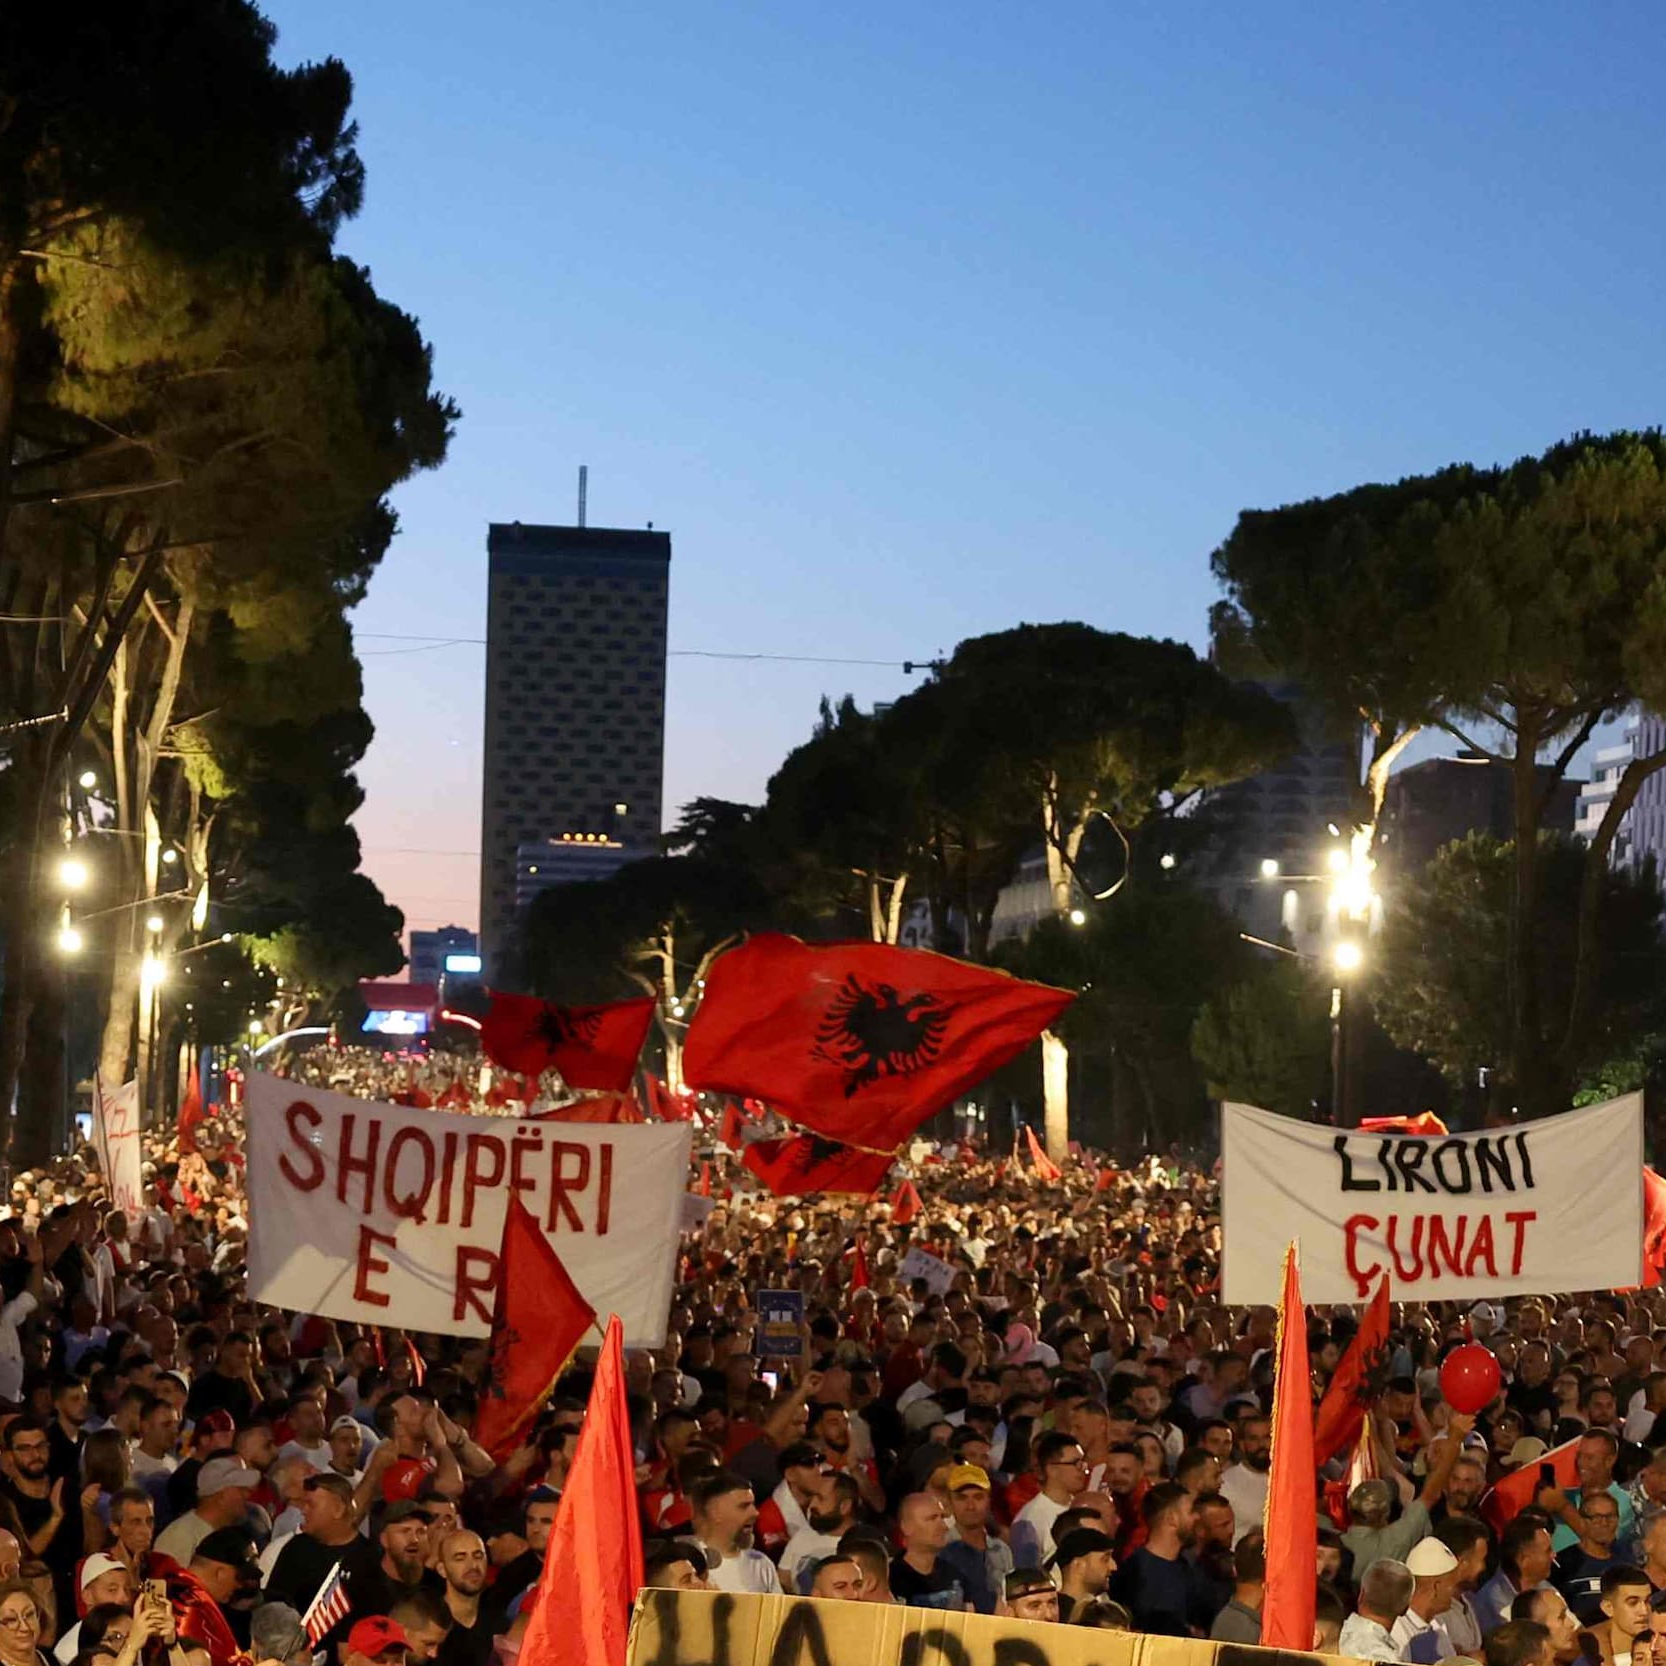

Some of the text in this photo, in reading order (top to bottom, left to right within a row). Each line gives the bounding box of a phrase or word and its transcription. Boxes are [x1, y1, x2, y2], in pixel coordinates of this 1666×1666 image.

[278, 1100, 613, 1237] SHQIPËRI
[1334, 1131, 1535, 1194] LIRONI
[353, 1224, 397, 1308] E
[1344, 1211, 1536, 1298] ÇUNAT
